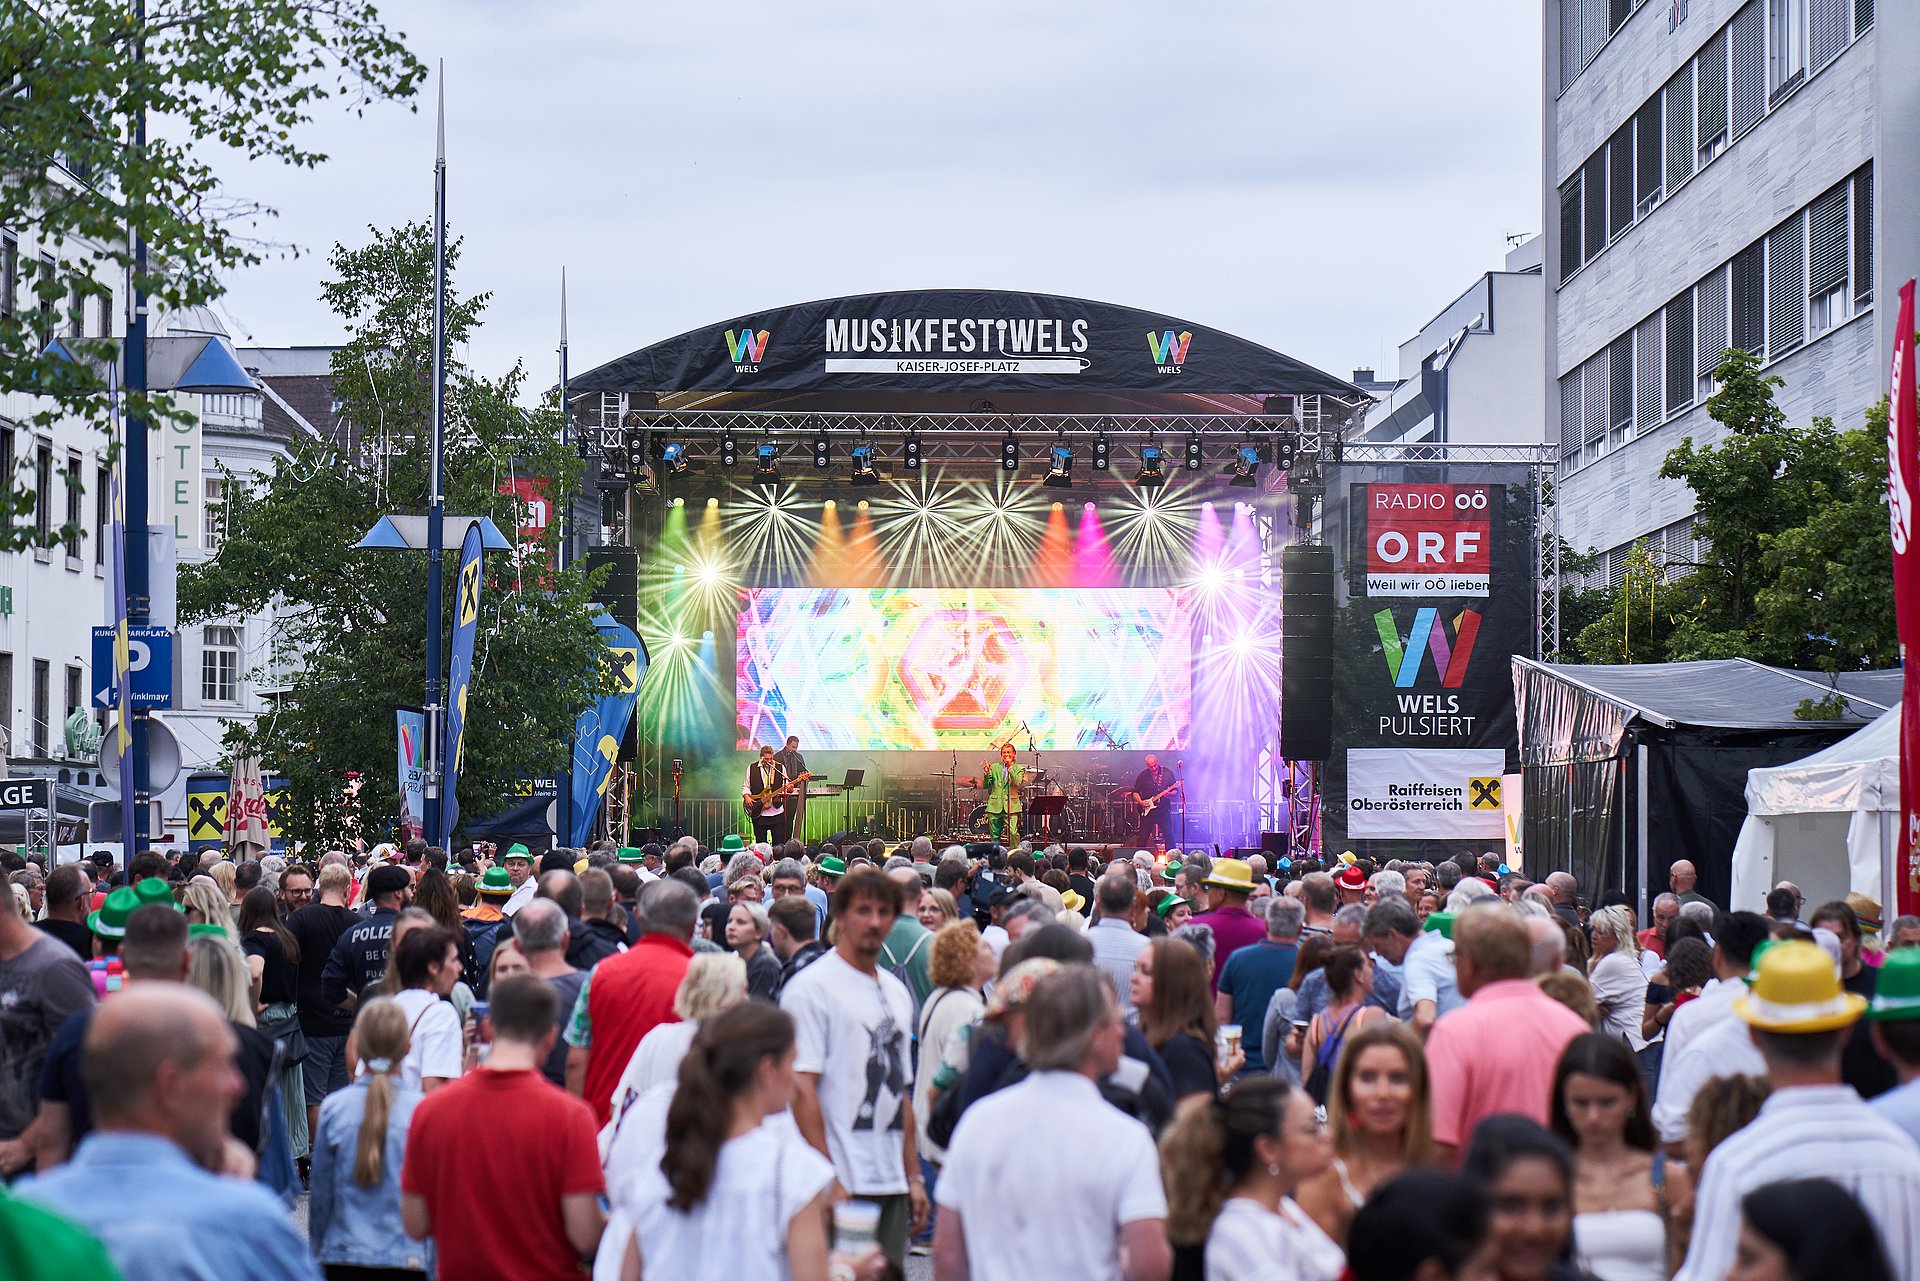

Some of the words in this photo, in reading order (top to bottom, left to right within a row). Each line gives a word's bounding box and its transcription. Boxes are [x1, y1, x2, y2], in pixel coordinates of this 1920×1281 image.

[734, 365, 759, 374] WELS
[896, 360, 1020, 373] KAISER-JOSEF-PLATZ
[1157, 366, 1182, 374] WELS
[171, 390, 195, 539] OTEL
[1375, 492, 1446, 510] RADIO
[1454, 489, 1488, 510] OÖ
[1376, 530, 1481, 563] ORF
[1368, 579, 1396, 590] Weil
[1400, 579, 1420, 590] wir
[1424, 577, 1446, 590] OÖ
[1450, 579, 1489, 590] lieben
[94, 630, 170, 638] KUNDPARKPLATZ
[131, 692, 169, 702] inklmayr
[1396, 694, 1460, 714] WELS
[1379, 716, 1476, 736] PULSIERT
[534, 779, 558, 788] WEL
[1388, 782, 1462, 796] Raiffeisen
[0, 785, 33, 806] GE
[1350, 798, 1463, 811] Oberösterreich
[352, 925, 393, 943] POLIZ
[365, 951, 380, 961] BE
